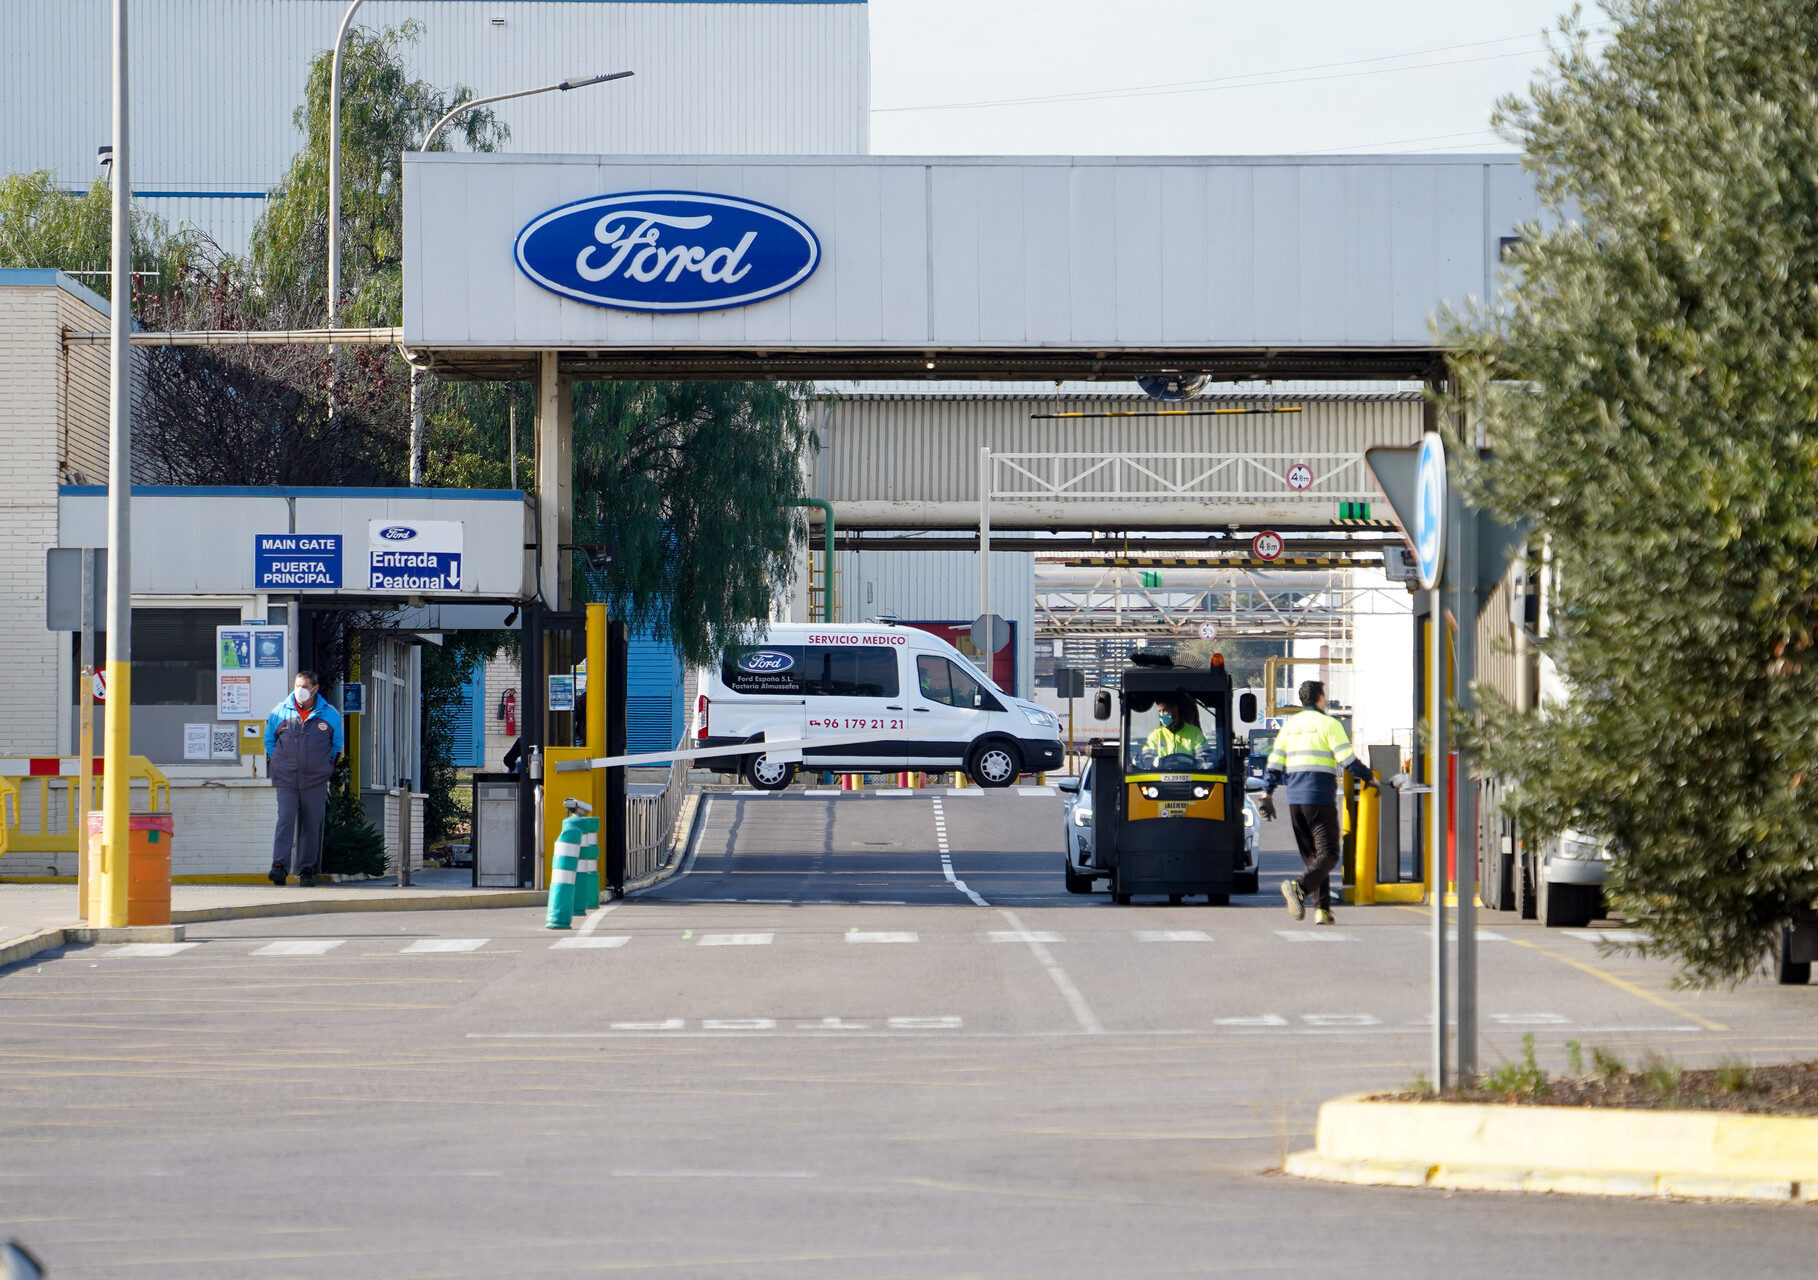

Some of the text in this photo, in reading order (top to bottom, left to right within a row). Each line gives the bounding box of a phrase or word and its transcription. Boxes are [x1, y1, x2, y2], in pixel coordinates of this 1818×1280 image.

[576, 210, 758, 285] Ford
[386, 528, 410, 540] Ford
[262, 539, 335, 550] MAIN GATE
[372, 552, 437, 568] Entrada
[272, 562, 326, 572] PUERTA
[263, 573, 334, 584] PRINCIPAL
[372, 573, 445, 589] Peatonal
[808, 634, 906, 645] SERVICIO MÉDICO
[748, 653, 782, 668] Ford
[737, 675, 753, 683] Ford
[755, 675, 779, 684] España
[824, 718, 905, 730] 96 179 21 21
